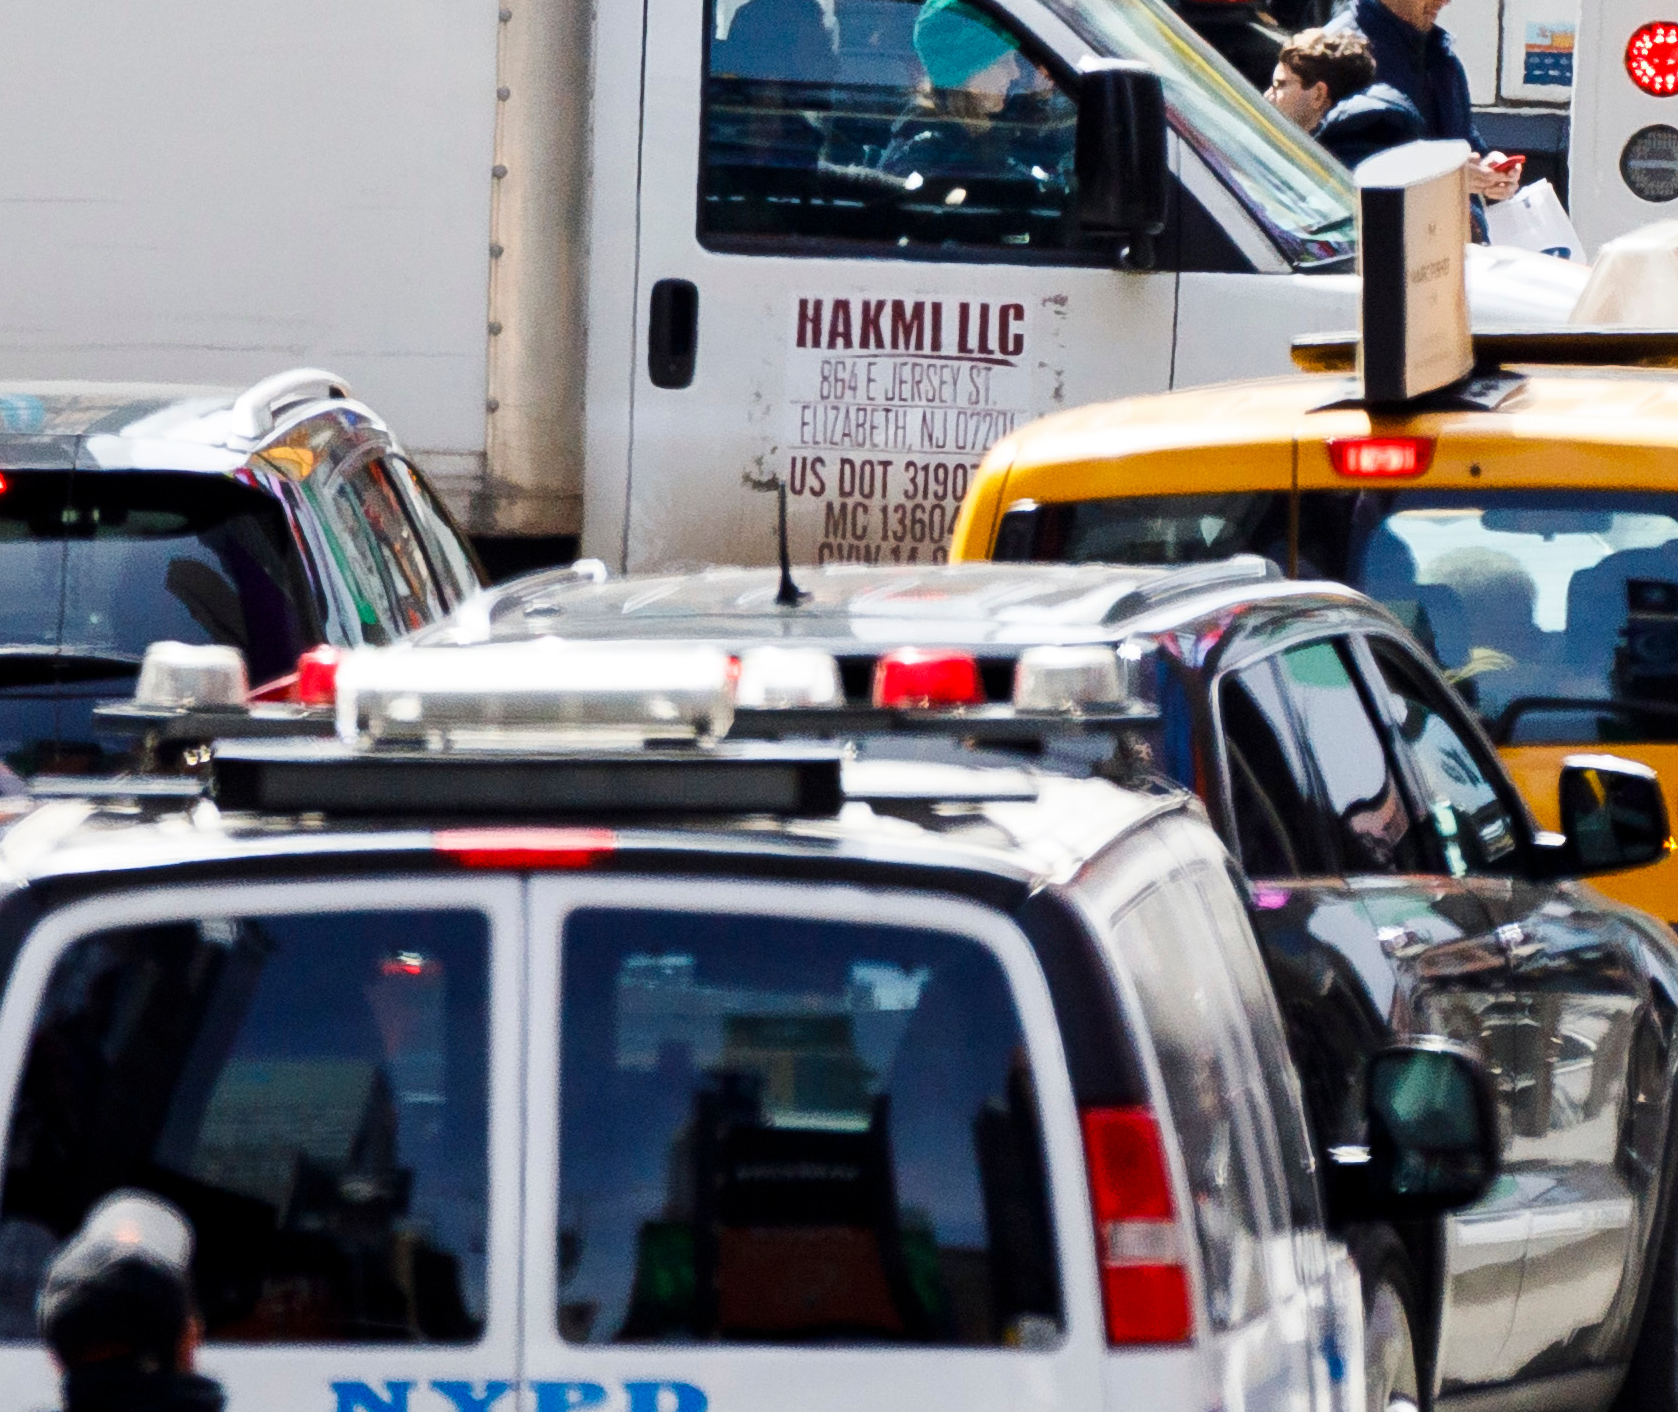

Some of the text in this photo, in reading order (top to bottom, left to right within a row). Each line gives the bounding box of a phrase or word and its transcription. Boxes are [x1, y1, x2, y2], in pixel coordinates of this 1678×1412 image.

[795, 297, 1026, 358] HAKMI LLC
[817, 359, 997, 407] 864 E JERSEY ST.
[799, 403, 912, 450] ELIZABETH,
[919, 407, 949, 451] NJ
[789, 456, 826, 498] US
[838, 459, 893, 500] DOT
[823, 501, 869, 541] MC
